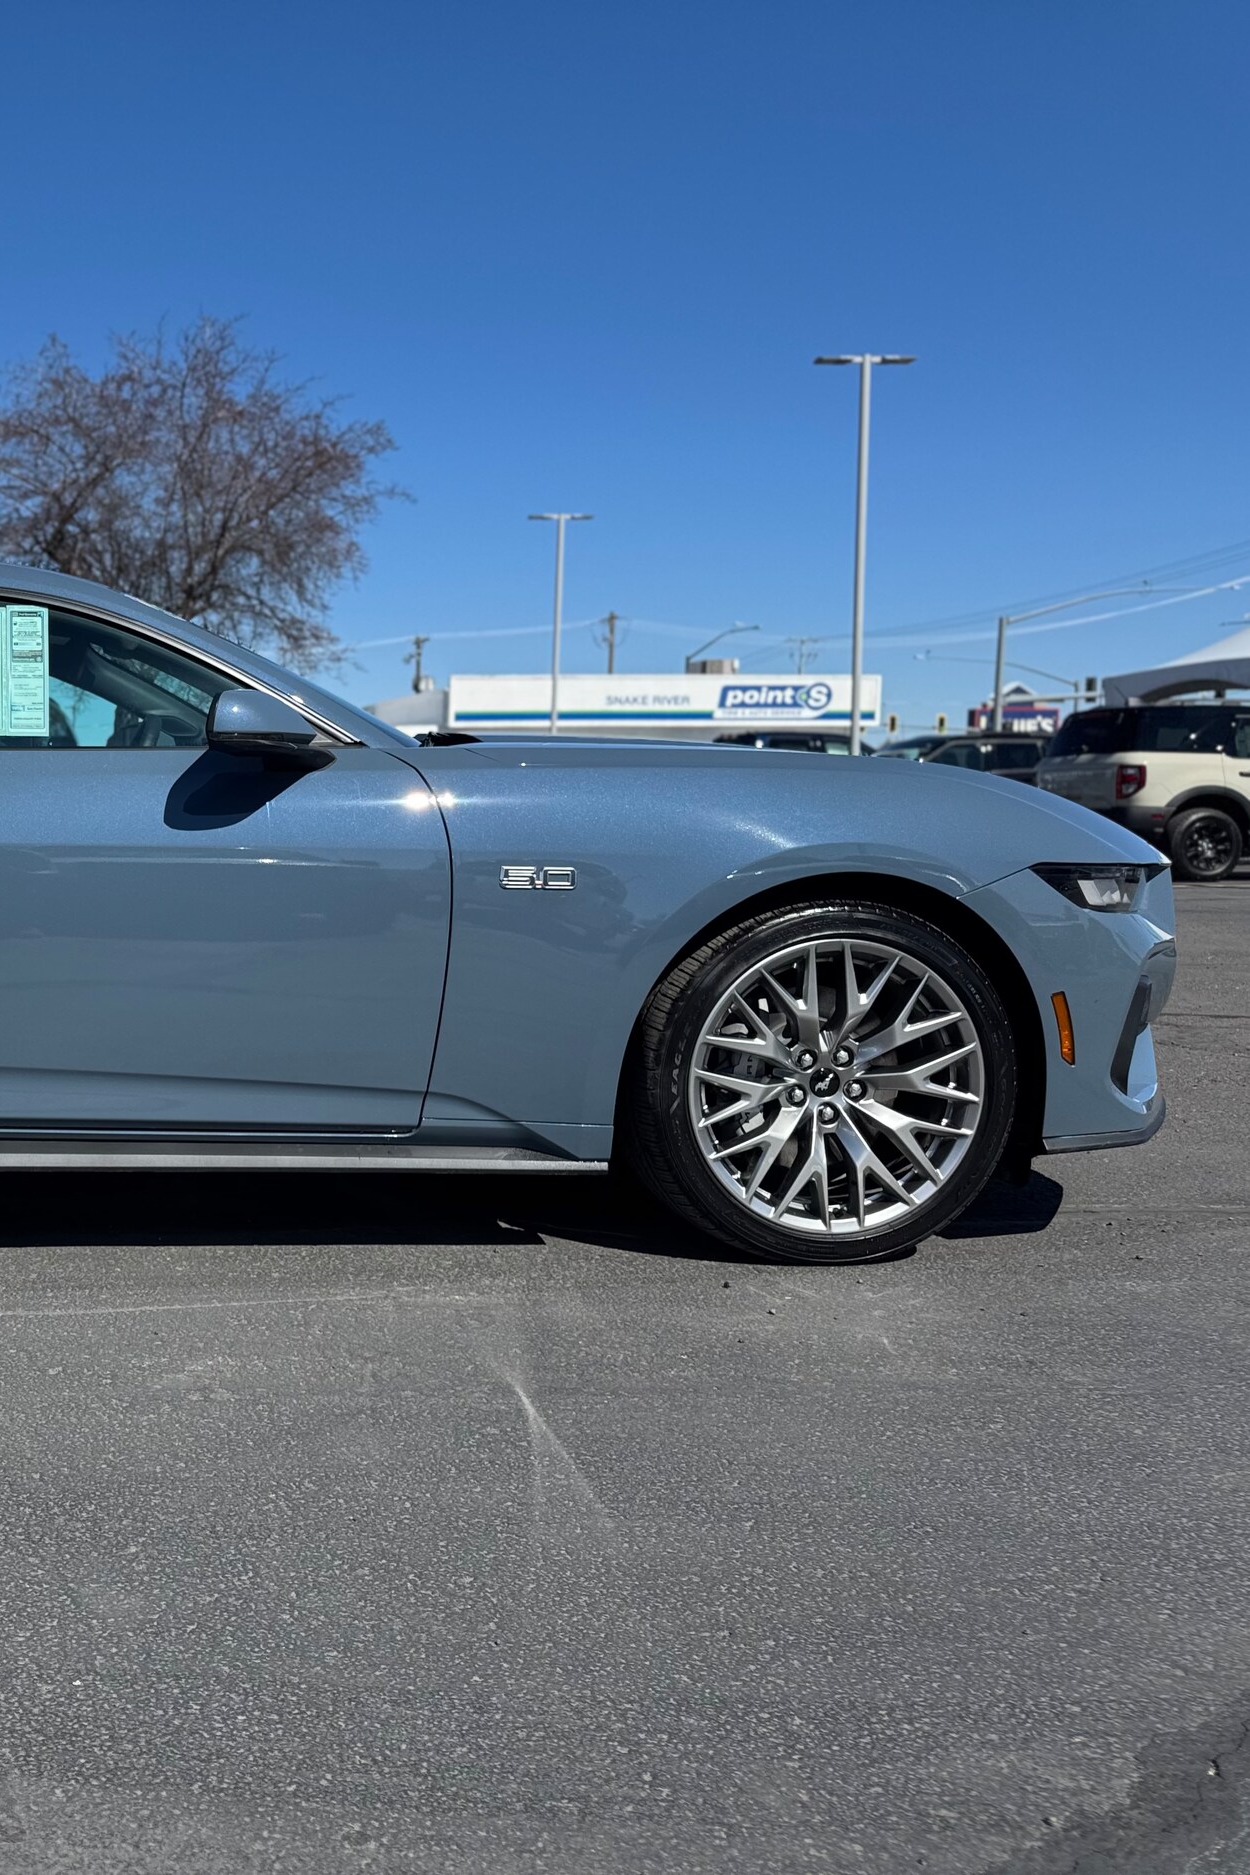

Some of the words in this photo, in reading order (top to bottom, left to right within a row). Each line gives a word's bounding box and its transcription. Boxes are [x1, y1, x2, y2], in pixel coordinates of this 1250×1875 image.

[605, 694, 649, 706] SNAKE
[652, 694, 691, 706] RIVER
[724, 686, 795, 707] point
[806, 684, 829, 708] S
[500, 865, 578, 890] 5.0
